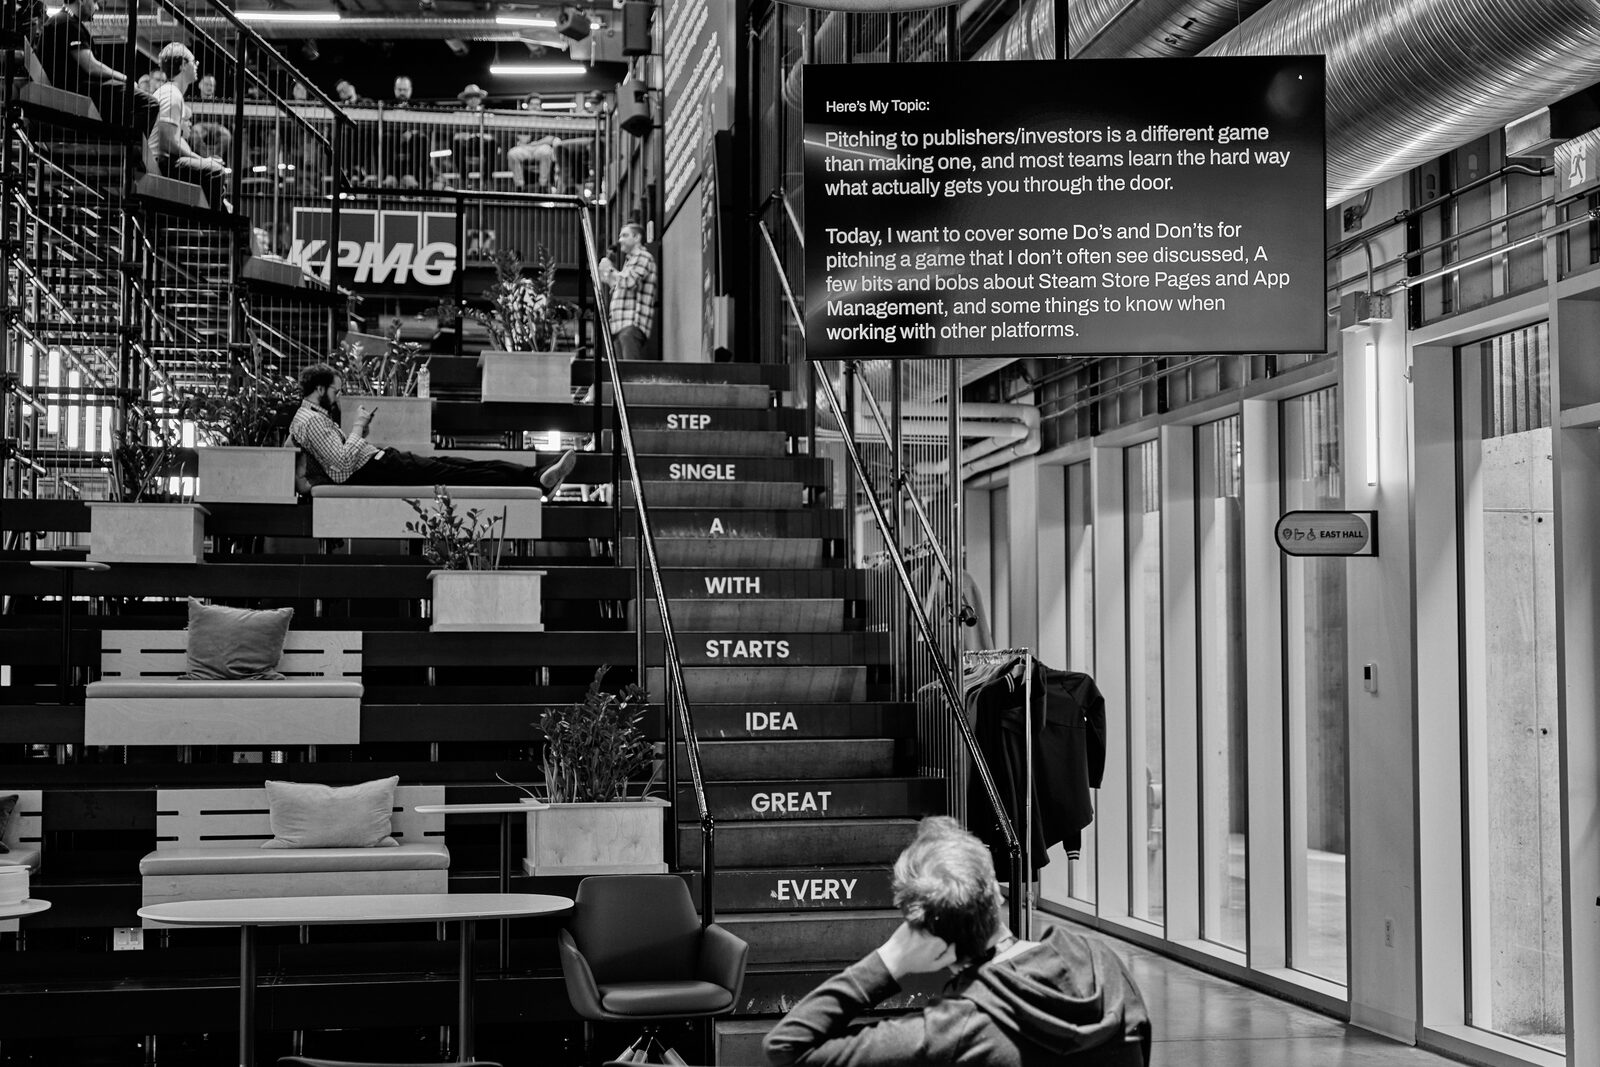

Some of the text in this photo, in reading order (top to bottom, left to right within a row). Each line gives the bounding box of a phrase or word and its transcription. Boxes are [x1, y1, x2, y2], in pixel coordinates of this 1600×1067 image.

[869, 100, 889, 114] My
[891, 98, 930, 114] Topic:
[825, 125, 1269, 150] Pitching to publishers/investors is a different game
[824, 148, 1291, 175] than making one, and most teams learn the hard way
[824, 174, 1173, 198] what actually gets you through the door.
[825, 227, 882, 247] Today,
[888, 227, 892, 243] I
[896, 227, 939, 243] want
[942, 226, 960, 242] to
[964, 228, 1015, 242] cover
[1018, 227, 1068, 241] some
[1117, 222, 1150, 239] and
[1217, 221, 1242, 237] for
[287, 239, 457, 286] KPMG
[826, 251, 896, 271] pitching
[900, 254, 912, 267] a
[915, 252, 965, 270] game
[969, 249, 1004, 266] that
[1009, 250, 1012, 265] I
[1067, 248, 1111, 264] often
[1116, 251, 1148, 263] see
[1153, 245, 1248, 264] discussed,
[1254, 246, 1268, 261] A
[825, 270, 1290, 292] few bits and bobs about Steam Store Pages and App
[827, 295, 1225, 319] Management, and some things to know when
[826, 321, 1079, 343] working with other platforms.
[666, 413, 712, 430] STEP
[668, 463, 736, 481] SINGLE
[709, 517, 725, 535] A
[1320, 530, 1364, 539] EAST HALL
[704, 576, 761, 595] WITH
[705, 639, 790, 659] STARTS
[745, 711, 799, 731] IDEA
[750, 791, 832, 814] GREAT
[776, 878, 858, 901] EVERY
